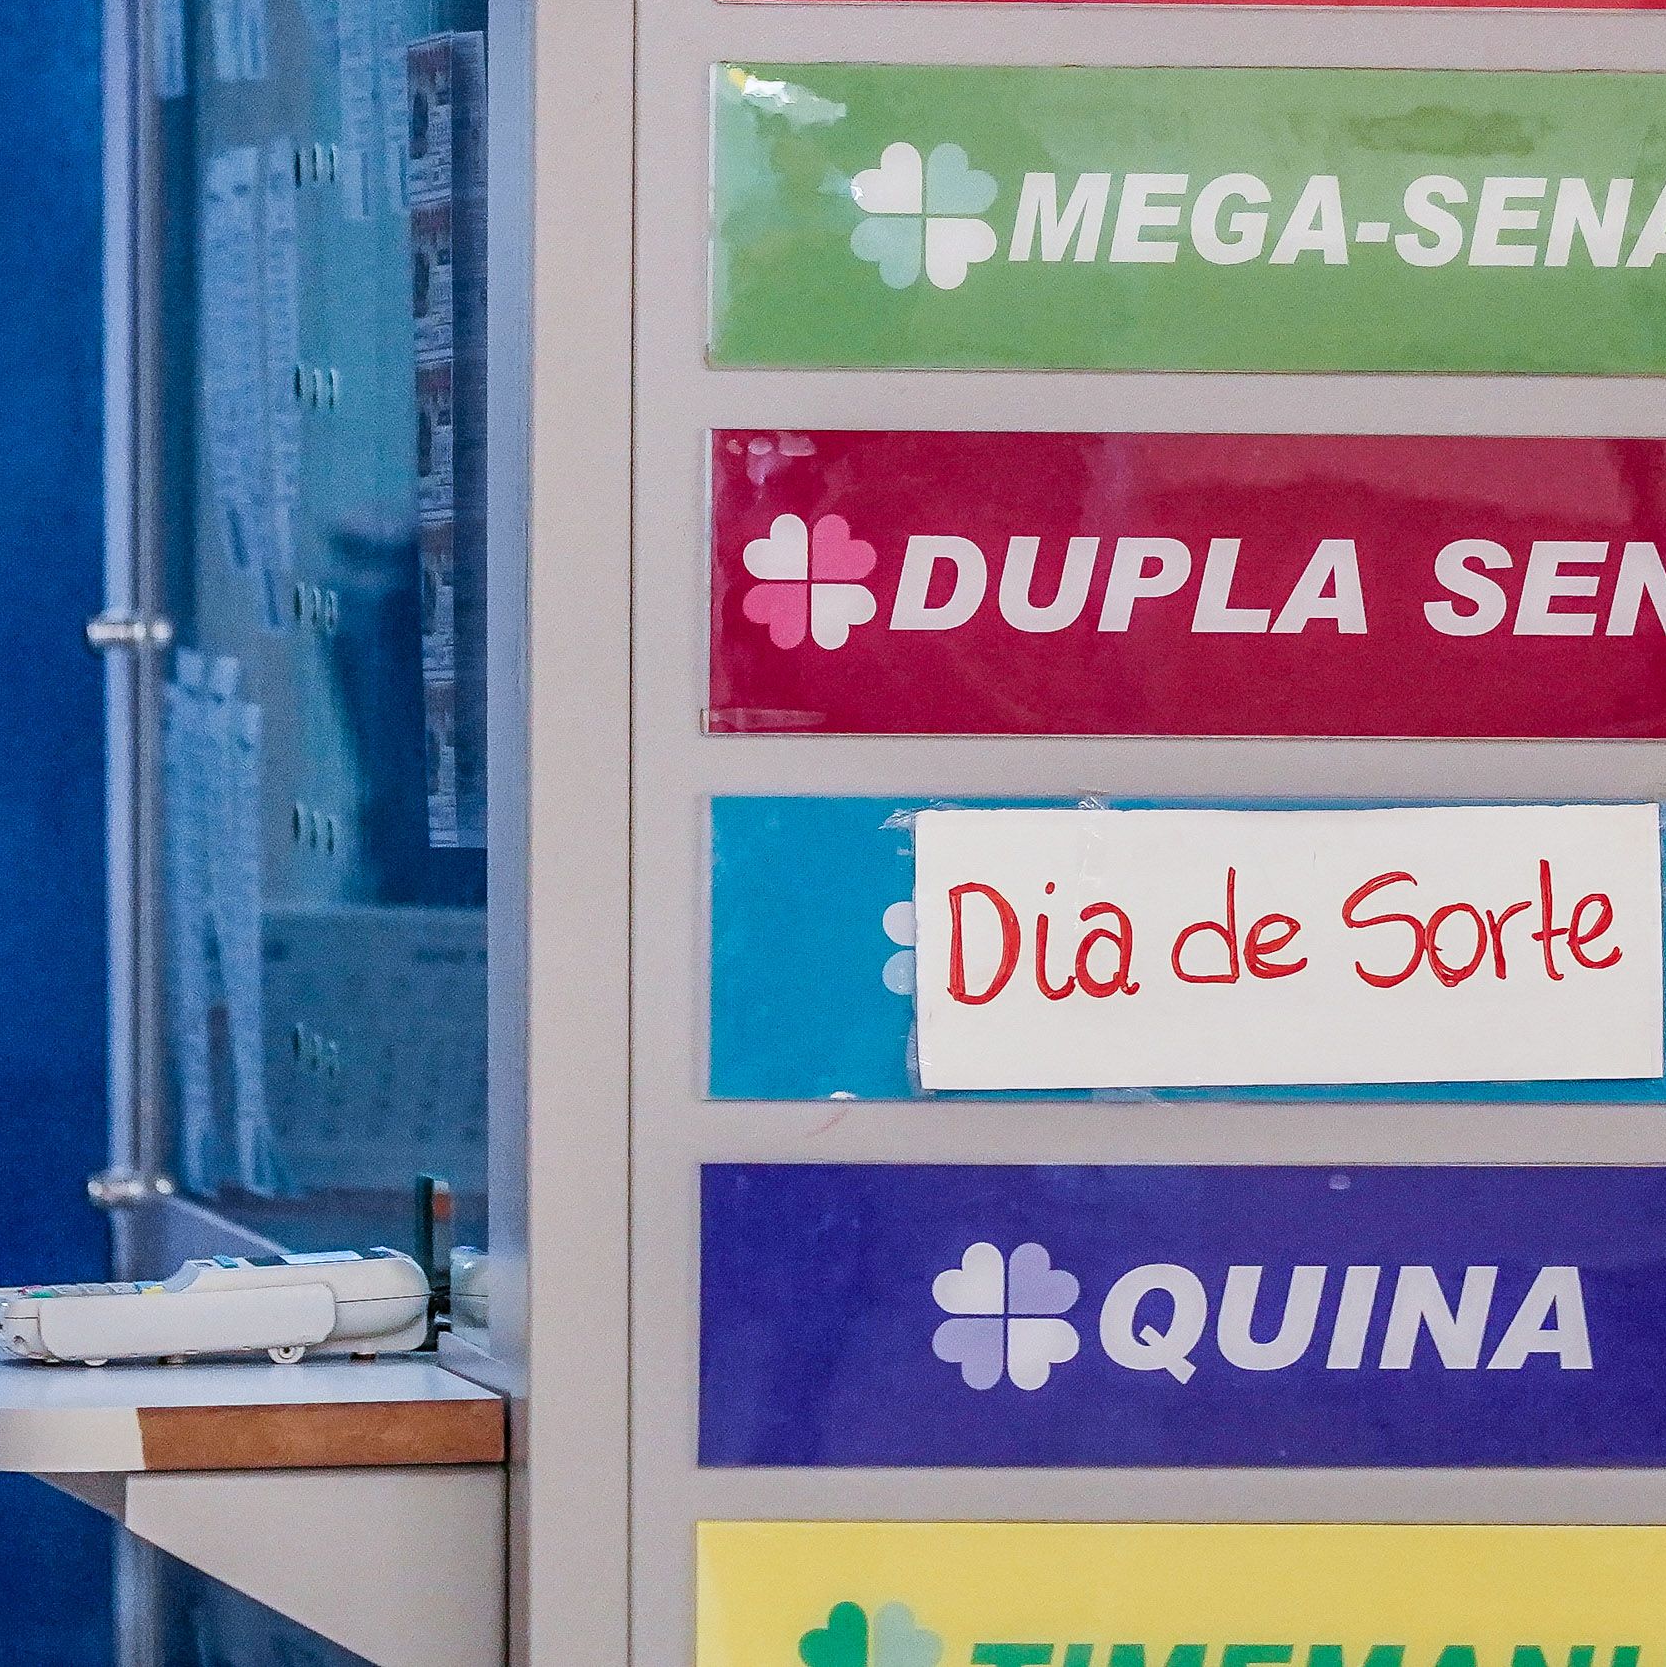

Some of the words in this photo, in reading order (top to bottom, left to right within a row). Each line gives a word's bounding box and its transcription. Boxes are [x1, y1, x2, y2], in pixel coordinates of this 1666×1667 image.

[888, 534, 1369, 635] DUPLA
[945, 880, 1141, 1007] Dia
[1170, 866, 1309, 986] de
[1340, 858, 1624, 990] Sorte
[1098, 1262, 1595, 1385] QUINA
